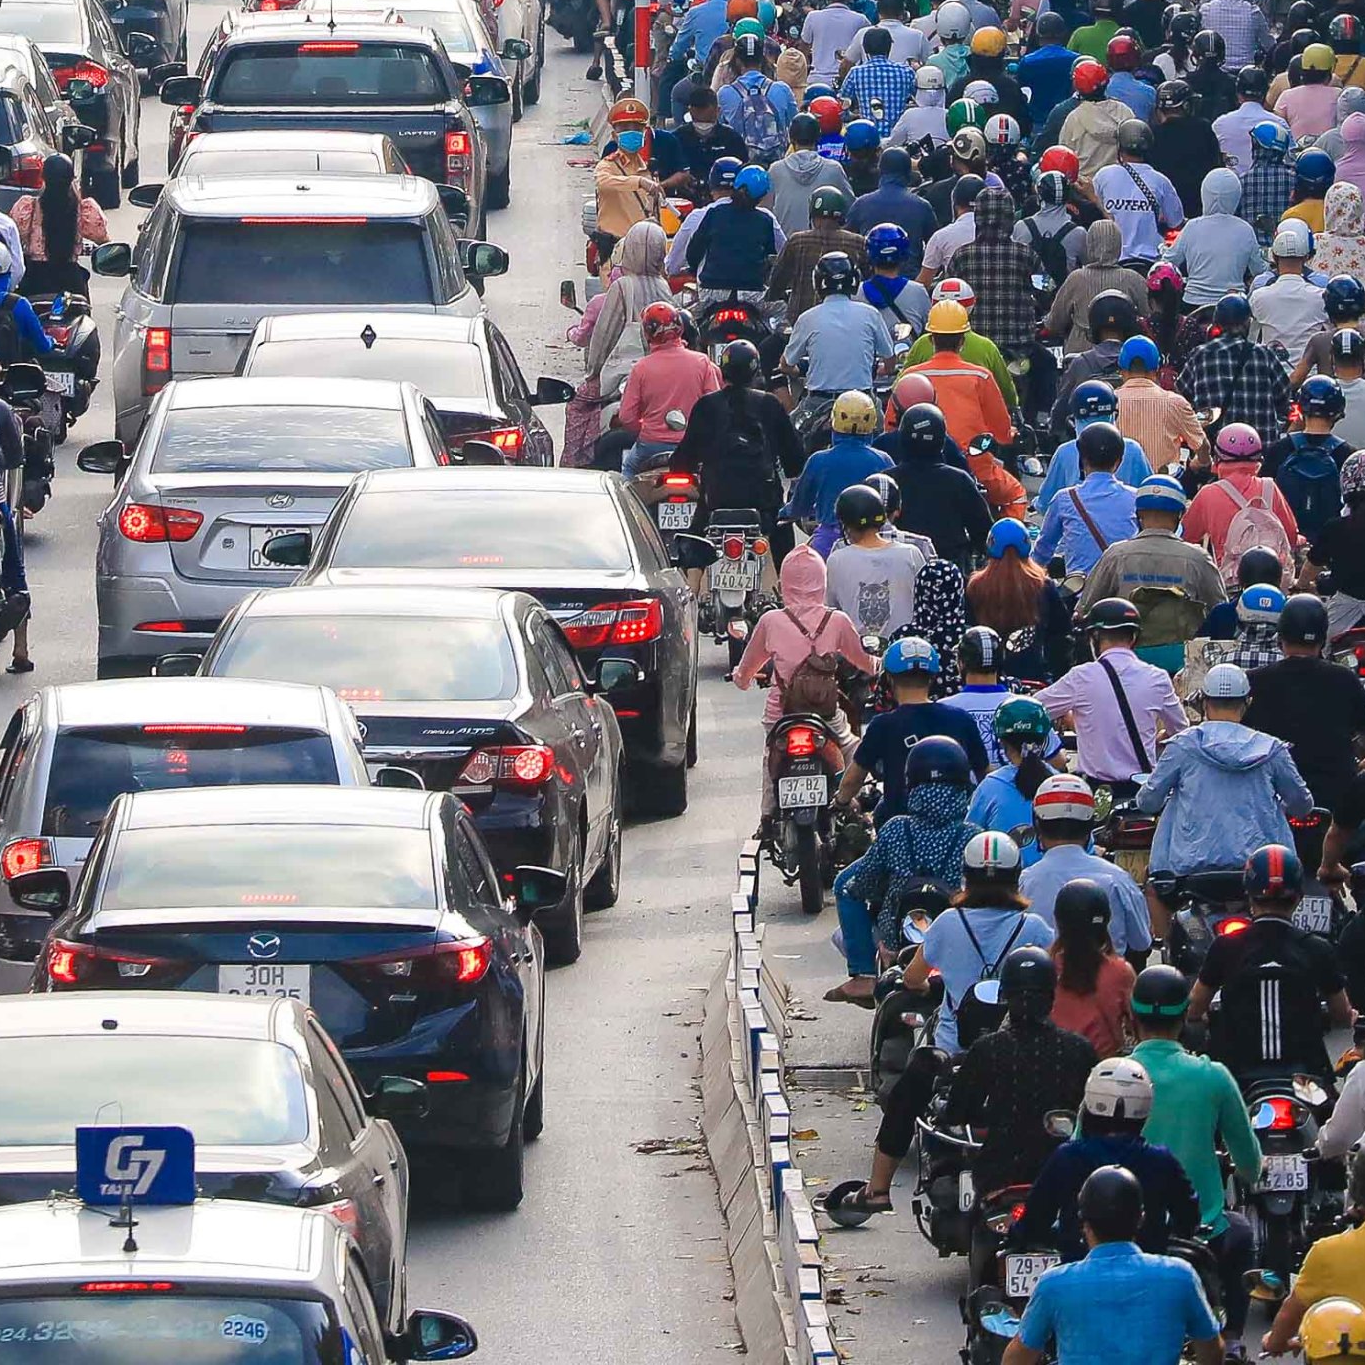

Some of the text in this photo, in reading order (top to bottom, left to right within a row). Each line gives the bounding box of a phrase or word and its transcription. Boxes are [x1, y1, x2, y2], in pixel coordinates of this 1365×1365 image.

[787, 777, 821, 792] 37-B2
[783, 791, 826, 807] 794.97
[245, 965, 284, 985] 30H
[104, 1135, 165, 1195] G7
[224, 1320, 265, 1338] 2246
